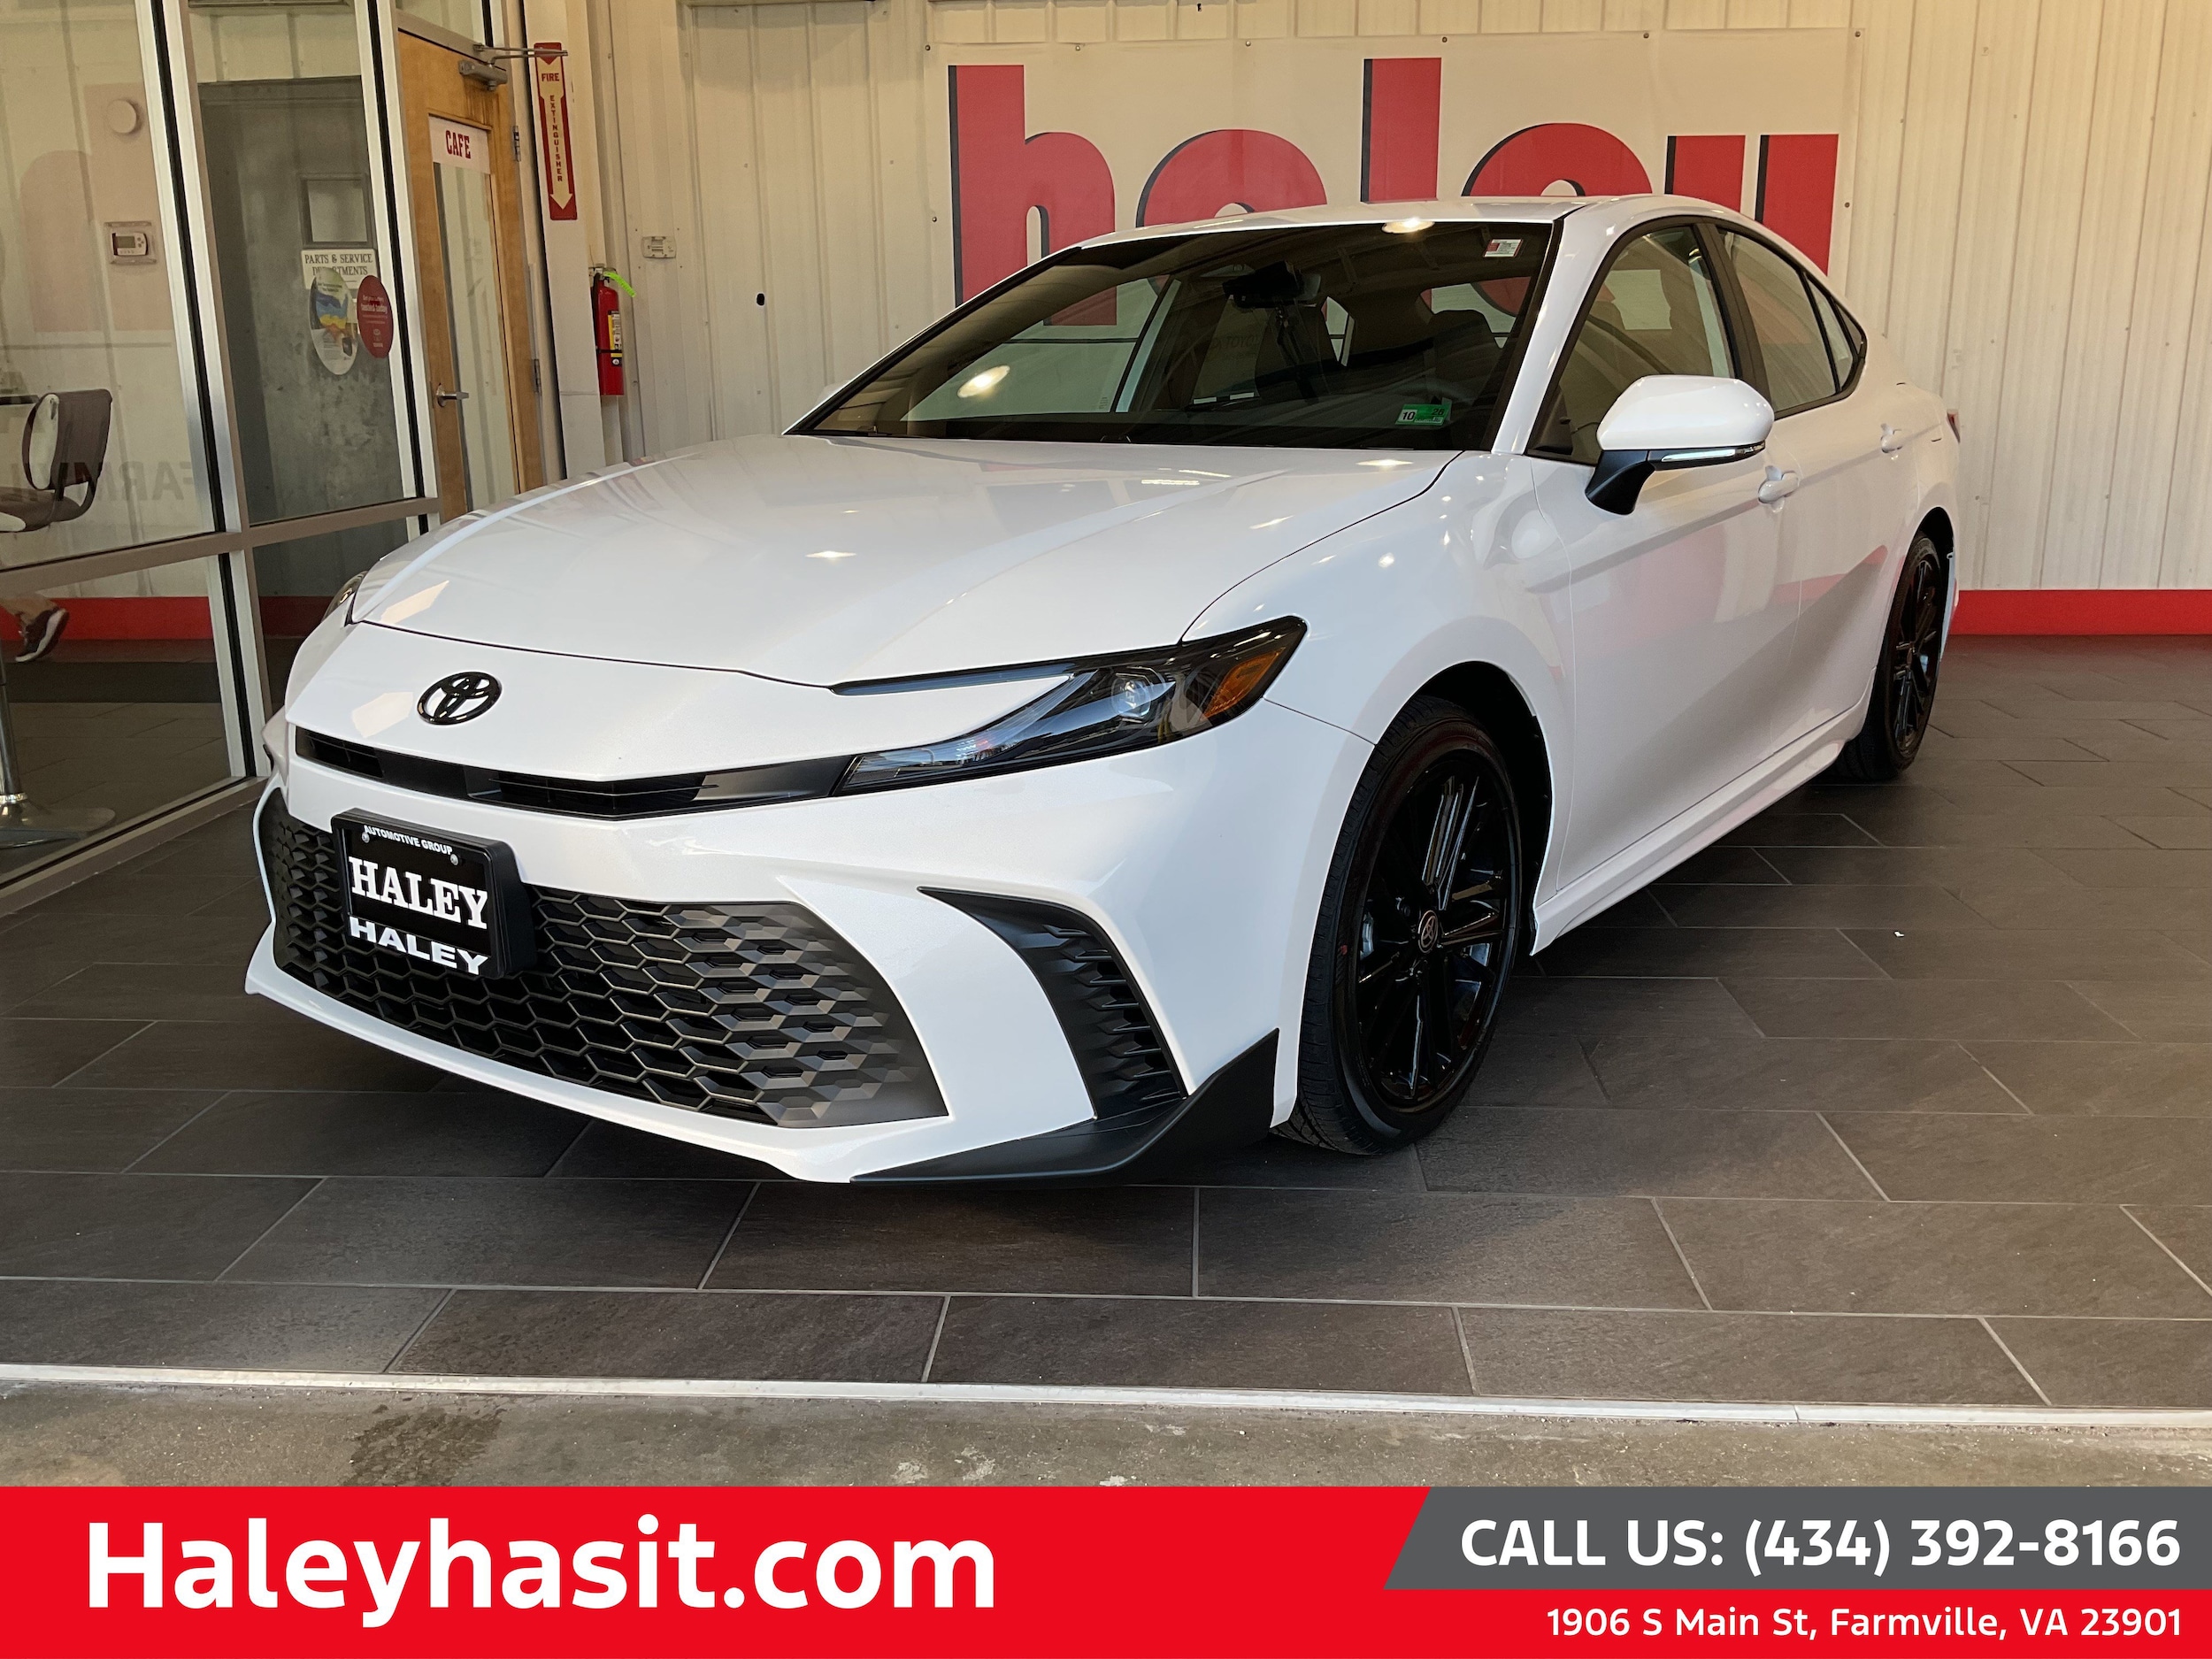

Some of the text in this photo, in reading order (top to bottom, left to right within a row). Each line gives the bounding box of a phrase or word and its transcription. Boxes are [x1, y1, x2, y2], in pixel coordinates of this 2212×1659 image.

[541, 73, 560, 82] FIRE
[445, 130, 472, 159] CAFE
[549, 95, 564, 182] EXTINGUISHER
[304, 253, 373, 264] PARTS & SERVICE
[1402, 411, 1416, 420] 10
[364, 825, 453, 856] AUTOMOTIVE GROUP
[349, 856, 488, 929] HALEY
[349, 916, 488, 975] HALEY
